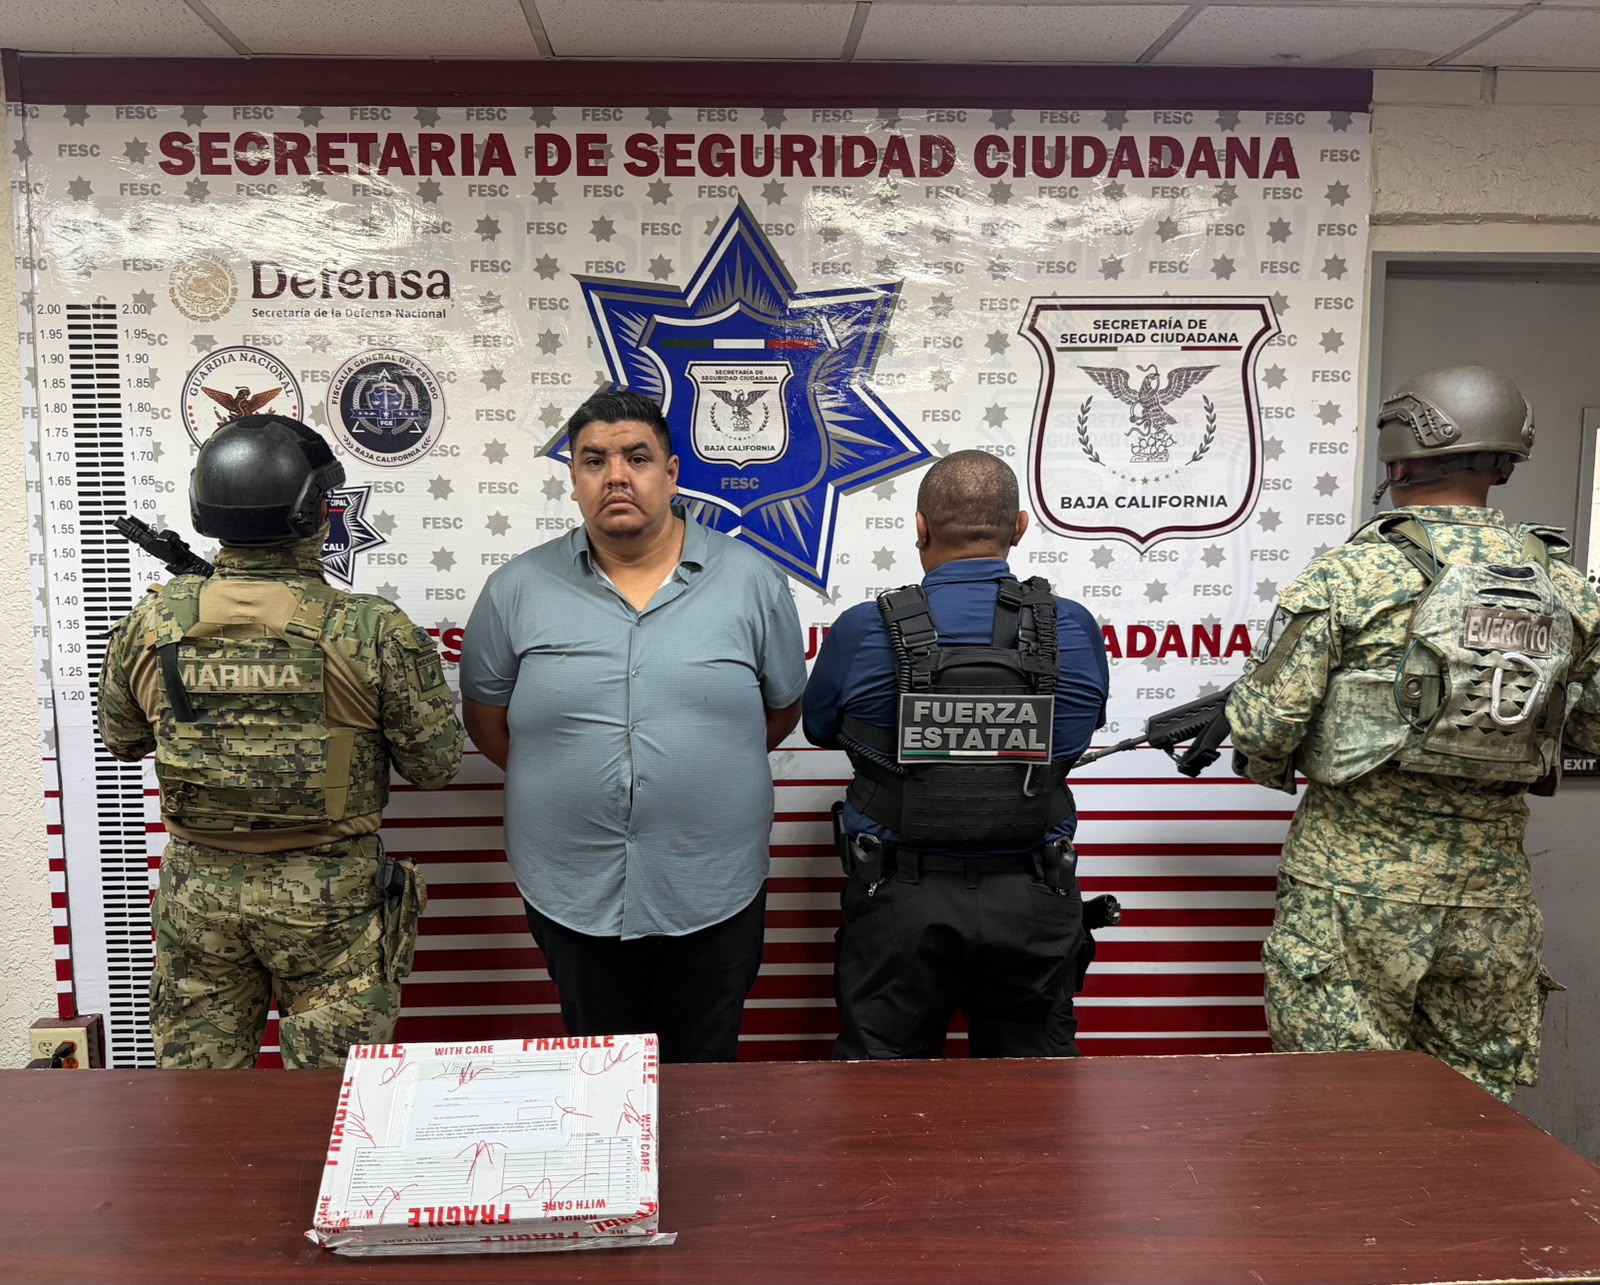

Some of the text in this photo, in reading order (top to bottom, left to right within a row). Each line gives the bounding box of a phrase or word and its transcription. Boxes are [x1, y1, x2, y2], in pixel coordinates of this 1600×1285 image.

[116, 107, 157, 120] FESC
[232, 107, 274, 120] FESC
[350, 108, 391, 121] FESC
[465, 108, 508, 121] FESC
[581, 108, 624, 121] FESC
[697, 109, 738, 122] FESC
[812, 109, 853, 122] FESC
[926, 110, 967, 123] FESC
[1039, 111, 1080, 124] FESC
[1153, 111, 1194, 125] FESC
[1265, 112, 1306, 125] FESC
[58, 144, 101, 157] FESC
[159, 132, 1300, 179] SECRETARIA DE SEGURIDAD CIUDADANA
[1320, 149, 1361, 162] FESC
[120, 183, 162, 196] FESC
[236, 183, 278, 196] FESC
[352, 184, 394, 197] FESC
[468, 184, 510, 197] FESC
[583, 185, 624, 198] FESC
[698, 185, 738, 198] FESC
[925, 186, 966, 199] FESC
[1038, 186, 1079, 199] FESC
[1262, 187, 1303, 200] FESC
[526, 222, 568, 235] FESC
[641, 223, 682, 236] FESC
[1206, 223, 1246, 236] FESC
[1317, 224, 1358, 236] FESC
[470, 260, 512, 272] FESC
[585, 261, 626, 273] FESC
[812, 261, 852, 274] FESC
[1037, 261, 1077, 273] FESC
[1149, 261, 1190, 274] FESC
[1260, 261, 1300, 274] FESC
[252, 261, 451, 300] Defensa
[37, 304, 61, 315] 2.00
[122, 304, 147, 315] 2.00
[528, 298, 570, 310] FESC
[980, 298, 1020, 311] FESC
[1314, 298, 1354, 310] FESC
[252, 307, 446, 319] Secretaría de la Defensa Nacional
[1093, 316, 1207, 330] SECRETARÍA DE
[40, 330, 63, 340] 1.95
[124, 329, 148, 339] 1.95
[242, 334, 283, 346] FESC
[1060, 333, 1239, 344] SEGURIDAD CIUDADANA
[473, 335, 514, 347] FESC
[923, 337, 963, 349] FESC
[1266, 334, 1298, 347] ESC
[41, 354, 64, 364] 1.90
[126, 354, 149, 364] 1.90
[189, 352, 294, 397] GUARDIA NACIONAL
[301, 370, 331, 382] FES
[354, 354, 395, 368] GENERAL
[398, 356, 415, 369] DEL
[416, 367, 438, 400] ESTADO
[530, 372, 572, 385] FESC
[978, 372, 1018, 385] FESC
[1312, 370, 1351, 382] FESC
[43, 379, 66, 389] 1.85
[127, 378, 150, 388] 1.85
[44, 403, 67, 413] 1.80
[128, 403, 151, 413] 1.80
[475, 409, 516, 421] FESC
[922, 410, 961, 422] FESC
[45, 427, 69, 437] 1.75
[129, 427, 152, 437] 1.75
[429, 445, 460, 457] ESC
[1309, 442, 1349, 454] FESC
[46, 452, 70, 462] 1.70
[130, 452, 154, 462] 1.70
[354, 446, 421, 463] BAJA CALIFORNIA
[48, 476, 71, 486] 1.65
[131, 476, 155, 486] 1.65
[721, 477, 760, 490] FESC
[1262, 479, 1292, 491] ESC
[478, 482, 519, 494] FESC
[50, 500, 73, 510] 1.60
[133, 500, 156, 510] 1.60
[1061, 495, 1228, 509] BAJA CALIFORNIA
[422, 517, 463, 530] FESC
[535, 518, 576, 530] FESC
[865, 518, 904, 530] FESC
[1306, 514, 1346, 525] FESC
[51, 524, 75, 534] 1.55
[52, 548, 76, 558] 1.50
[367, 553, 408, 565] FESC
[1029, 552, 1068, 563] FESC
[1250, 550, 1290, 561] FESC
[54, 572, 77, 582] 1.45
[137, 571, 160, 581] 1.45
[425, 588, 466, 600] FESC
[1083, 585, 1122, 597] FESC
[1193, 584, 1232, 596] FESC
[55, 596, 78, 606] 1.40
[56, 620, 80, 630] 1.35
[1467, 612, 1547, 651] EJÉRCITO
[57, 643, 81, 653] 1.30
[59, 667, 83, 677] 1.25
[178, 664, 301, 688] MARINA
[61, 691, 85, 701] 1.20
[1136, 688, 1176, 700] FESC
[913, 701, 1037, 724] FUERZA
[903, 727, 1046, 750] ESTATAL
[1563, 759, 1596, 770] EXIT
[522, 1036, 615, 1052] FRAGILE
[434, 1045, 494, 1056] WITH CARE
[640, 1143, 651, 1172] CARE
[542, 1199, 606, 1211] WITH CARE
[408, 1203, 512, 1228] FRAGILE
